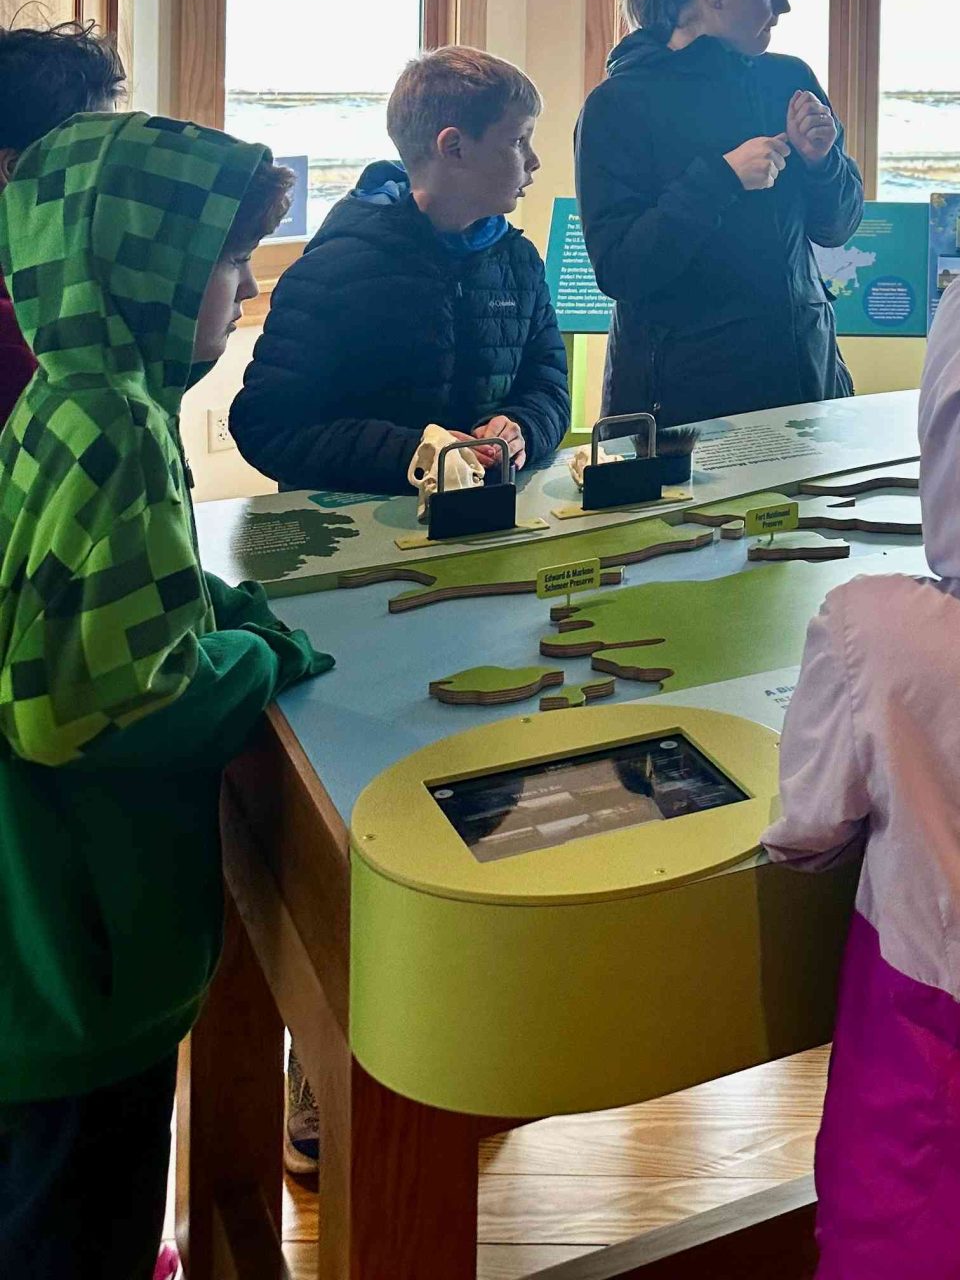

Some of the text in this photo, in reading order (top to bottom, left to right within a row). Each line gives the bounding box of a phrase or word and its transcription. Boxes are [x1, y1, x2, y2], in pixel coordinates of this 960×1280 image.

[545, 571, 565, 582] Edward
[566, 570, 570, 578] &
[570, 578, 593, 587] Preserve
